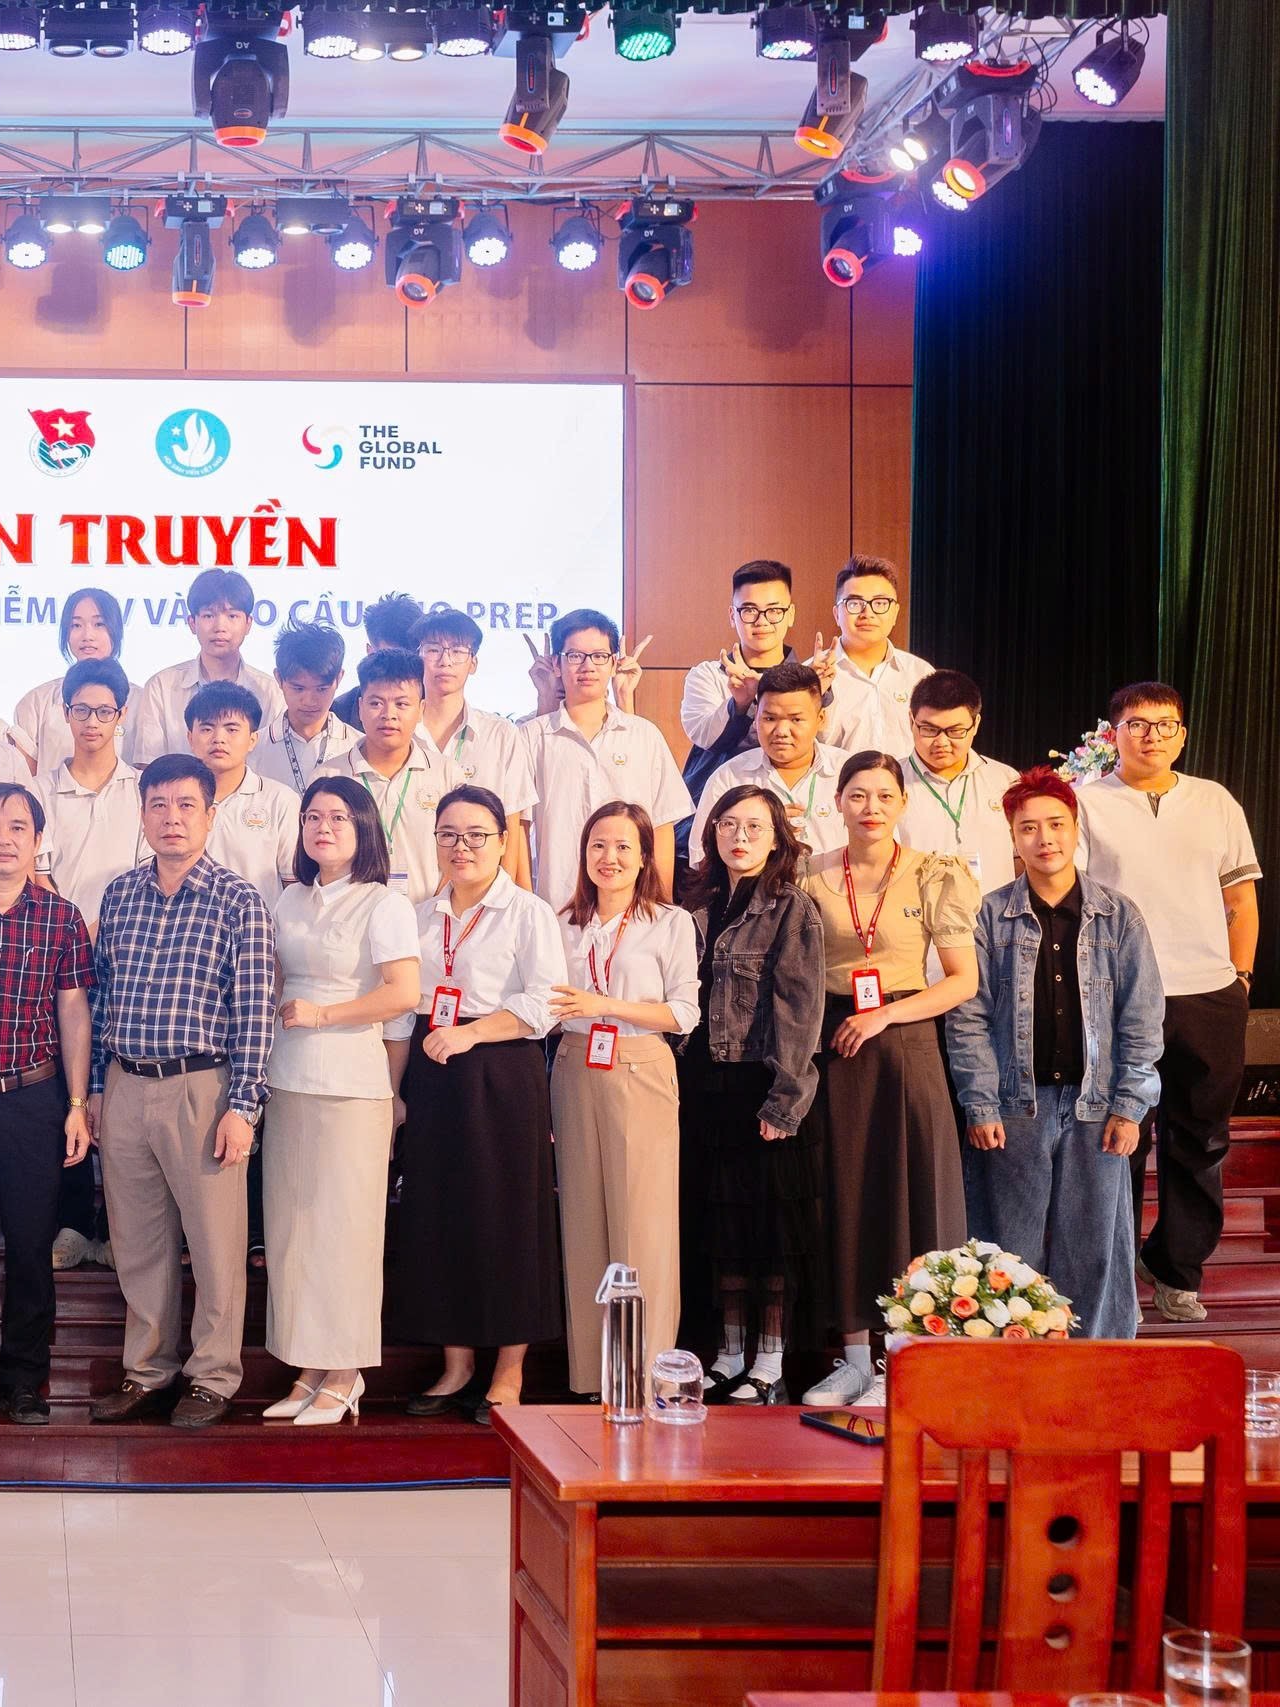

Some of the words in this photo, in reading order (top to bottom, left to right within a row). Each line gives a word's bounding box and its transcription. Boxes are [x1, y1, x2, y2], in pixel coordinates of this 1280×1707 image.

[359, 425, 399, 438] THE
[359, 441, 442, 454] GLOBAL
[360, 457, 417, 470] FUND
[59, 498, 337, 567] TRUYỀN
[467, 601, 558, 629] PREP
